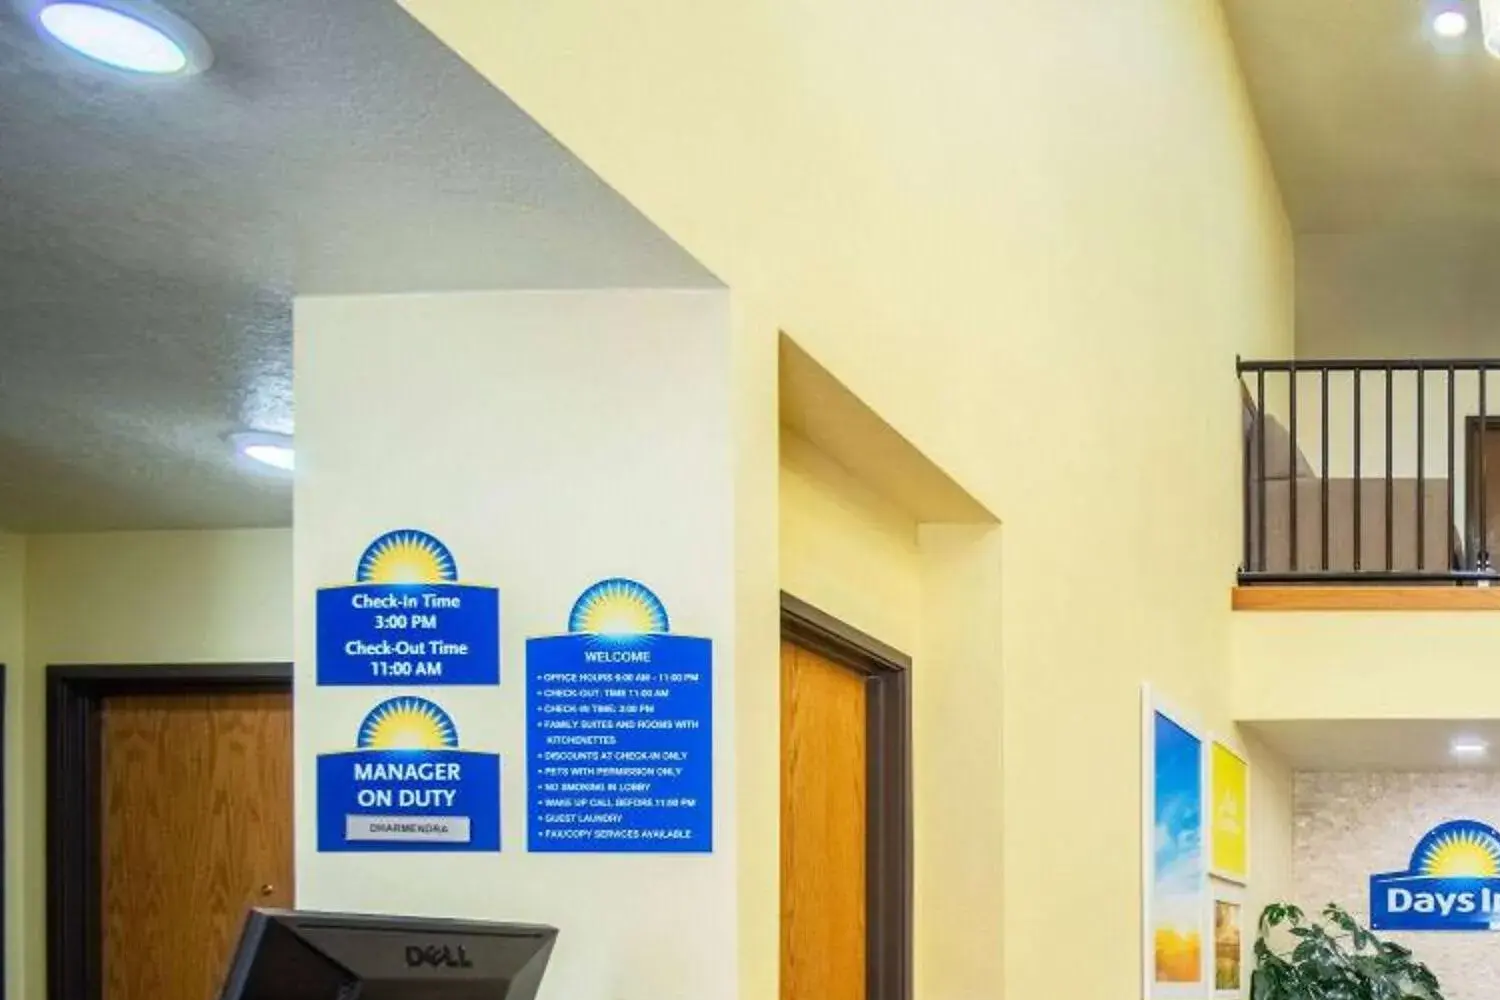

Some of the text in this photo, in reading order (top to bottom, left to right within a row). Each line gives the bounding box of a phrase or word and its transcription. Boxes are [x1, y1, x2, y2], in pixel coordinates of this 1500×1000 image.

[351, 593, 461, 609] Check-In Time
[374, 615, 437, 629] 3:00 PM
[344, 640, 469, 655] Check-Out Time
[584, 651, 651, 663] WELCOME
[370, 661, 442, 676] 11:00 AM
[543, 673, 577, 683] OFFICE
[578, 673, 612, 683] HOURS
[635, 673, 651, 683] AM
[684, 673, 699, 683] PM
[654, 688, 669, 698] AM
[543, 719, 699, 729] FAMILY SUITES AND ROOMS WITH
[544, 751, 599, 761] DISCOUNTS
[600, 751, 613, 761] AT
[662, 751, 689, 761] ONLY
[354, 763, 461, 781] MANAGER
[544, 767, 683, 776] PETS WITH PERMISSION ONLY
[544, 783, 651, 792] NO SMOKING IN LOBBY
[357, 789, 457, 807] ON DUTY
[575, 798, 589, 808] UP
[590, 798, 611, 808] CALL
[614, 798, 652, 808] BEFORE
[680, 798, 697, 808] PM
[544, 814, 623, 823] GUEST LAUNDRY
[641, 829, 693, 839] AVAILABLE
[1387, 888, 1475, 916] Days
[405, 944, 474, 968] DELL
